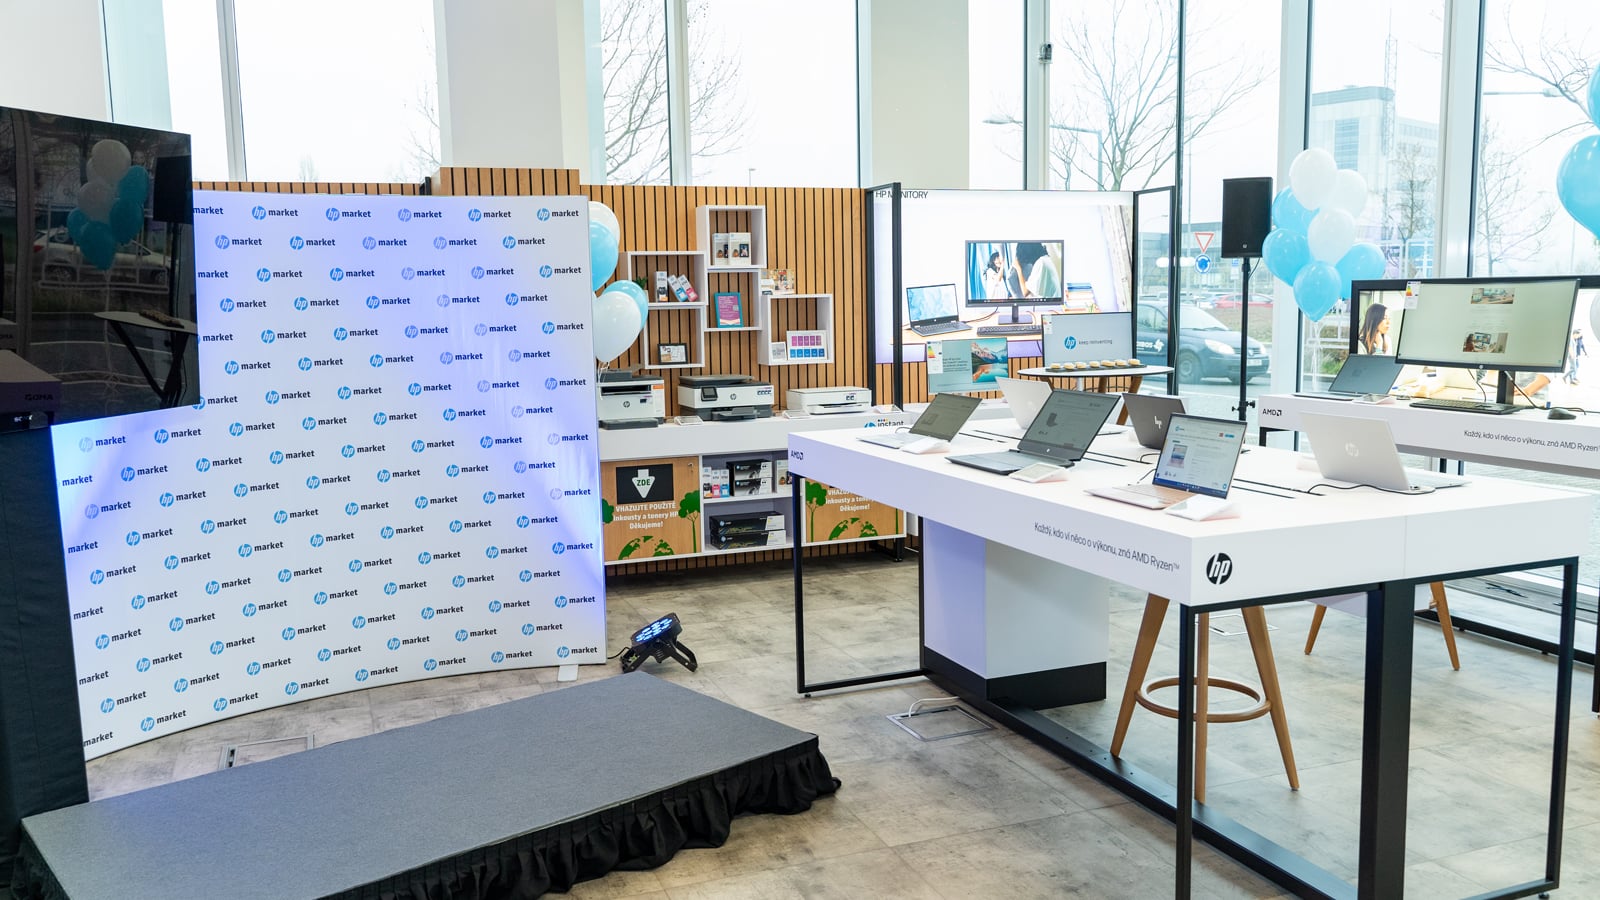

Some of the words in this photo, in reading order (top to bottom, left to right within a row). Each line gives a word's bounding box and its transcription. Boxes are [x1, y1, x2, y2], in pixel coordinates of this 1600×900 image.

[192, 206, 224, 215] market
[251, 206, 268, 220] hp
[269, 208, 298, 216] market
[326, 208, 340, 221] hp
[342, 210, 371, 218] market
[468, 209, 482, 221] hp
[537, 208, 550, 221] hp
[215, 235, 230, 249] hp
[233, 237, 262, 246] market
[199, 270, 228, 278] market
[257, 268, 271, 282] hp
[330, 268, 344, 281] hp
[540, 265, 553, 278] hp
[220, 298, 235, 312] hp
[236, 300, 267, 308] market
[334, 328, 348, 340] hp
[349, 328, 378, 336] market
[405, 325, 418, 338] hp
[542, 322, 555, 334] hp
[203, 333, 233, 341] market
[262, 330, 276, 343] hp
[277, 331, 307, 339] market
[1064, 336, 1076, 350] hp
[225, 361, 239, 374] hp
[241, 361, 271, 370] market
[338, 386, 352, 399] hp
[353, 387, 382, 395] market
[408, 383, 422, 395] hp
[207, 396, 238, 404] market
[266, 391, 280, 404] hp
[281, 391, 311, 399] market
[155, 429, 169, 443] hp
[171, 428, 201, 438] market
[230, 423, 244, 436] hp
[245, 422, 275, 431] market
[480, 436, 493, 448] hp
[791, 450, 801, 459] AMD
[196, 458, 211, 472] hp
[212, 457, 242, 466] market
[121, 467, 136, 481] hp
[137, 465, 168, 475] market
[377, 470, 391, 482] hp
[392, 469, 420, 478] market
[62, 475, 93, 486] market
[307, 476, 320, 489] hp
[322, 475, 351, 484] market
[160, 493, 174, 507] hp
[176, 491, 206, 501] market
[483, 491, 496, 504] hp
[498, 492, 525, 500] market
[649, 502, 676, 510] POUŽITÉ
[274, 511, 288, 523] hp
[290, 509, 318, 518] market
[201, 520, 215, 533] hp
[217, 518, 247, 528] market
[630, 521, 663, 529] Děkujeme!
[126, 532, 141, 545] hp
[142, 528, 173, 539] market
[1035, 522, 1052, 536] Každý,
[1053, 527, 1064, 539] kdo
[1065, 532, 1070, 540] ví
[1071, 533, 1086, 545] něco
[1093, 540, 1117, 556] výkonu,
[1118, 548, 1130, 559] zná
[1132, 550, 1149, 564] AMD
[68, 541, 98, 554] market
[419, 552, 432, 564] hp
[433, 551, 461, 560] market
[349, 560, 362, 572] hp
[364, 558, 392, 567] market
[1206, 552, 1233, 585] hp
[90, 570, 105, 584] hp
[106, 565, 136, 577] market
[278, 569, 292, 582] hp
[294, 567, 322, 577] market
[520, 570, 533, 582] hp
[533, 570, 560, 578] market
[206, 581, 220, 594] hp
[221, 577, 251, 588] market
[132, 595, 146, 609] hp
[147, 590, 178, 603] market
[73, 606, 103, 620] market
[353, 616, 366, 628] hp
[367, 614, 395, 623] market
[96, 635, 110, 650] hp
[112, 628, 141, 642] market
[282, 628, 296, 640] hp
[297, 624, 326, 635] market
[456, 630, 468, 641] hp
[470, 628, 497, 637] market
[210, 641, 224, 654] hp
[226, 636, 255, 648] market
[557, 646, 570, 658] hp
[137, 658, 151, 673] hp
[152, 652, 182, 665] market
[79, 671, 109, 685] market
[356, 669, 369, 681] hp
[370, 666, 398, 676] market
[286, 682, 299, 695] hp
[301, 678, 329, 689] market
[101, 698, 115, 713] hp
[116, 691, 146, 705] market
[214, 698, 228, 711] hp
[229, 692, 258, 704] market
[84, 731, 113, 747] market
